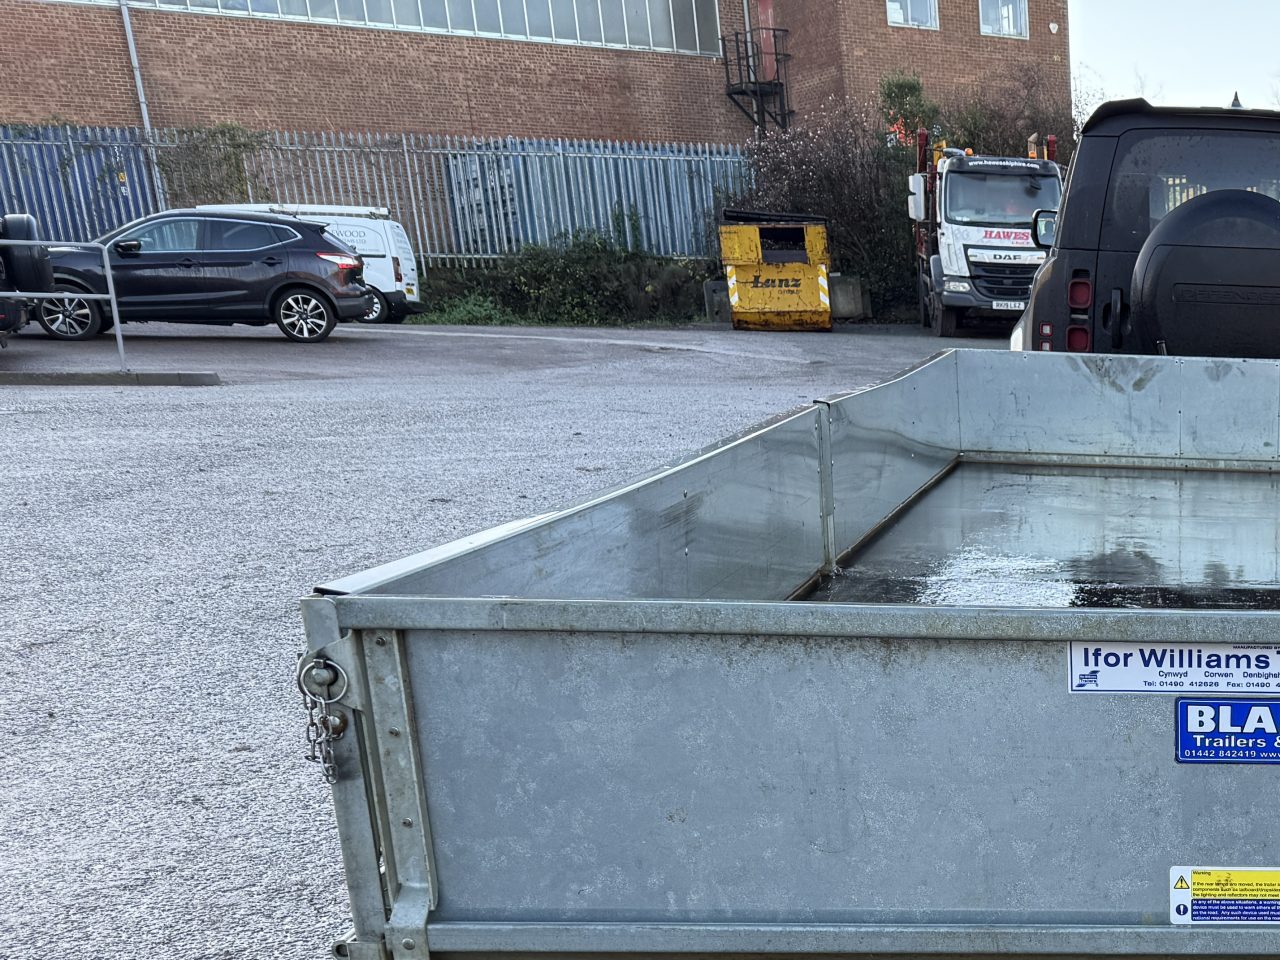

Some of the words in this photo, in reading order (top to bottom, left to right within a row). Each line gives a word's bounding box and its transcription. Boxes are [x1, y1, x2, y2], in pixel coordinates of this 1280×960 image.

[982, 229, 1031, 241] HAWES
[993, 253, 1022, 261] DAF
[1083, 647, 1133, 668] Ifor
[1138, 648, 1270, 669] Williams
[1158, 670, 1188, 678] Cynwyd
[1193, 735, 1266, 748] Trailers
[1218, 750, 1256, 758] 842419
